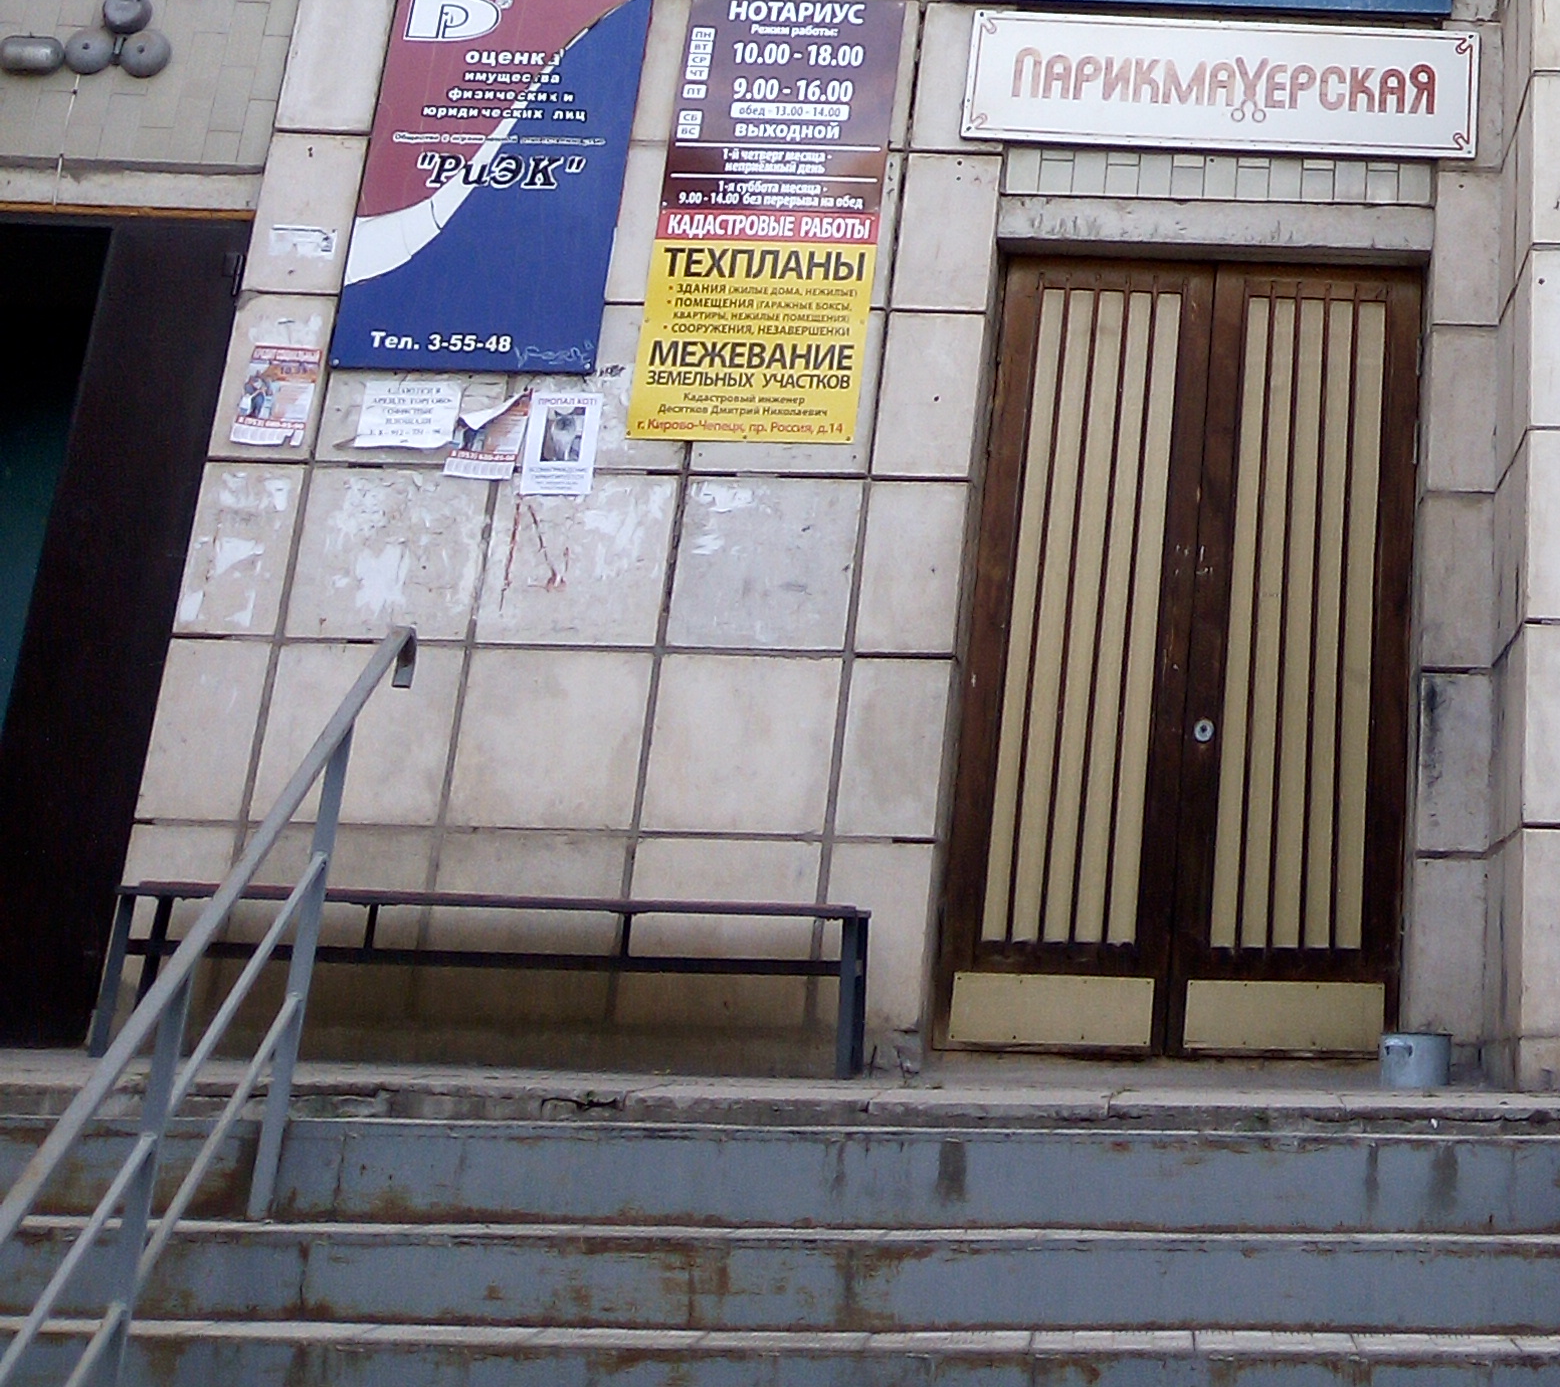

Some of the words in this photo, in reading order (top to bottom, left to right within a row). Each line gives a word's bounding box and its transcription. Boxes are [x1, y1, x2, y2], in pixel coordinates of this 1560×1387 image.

[728, 0, 865, 25] НОТАРИУС
[751, 24, 789, 36] Режим
[791, 26, 839, 38] работы:
[733, 43, 790, 65] 10.00
[808, 45, 864, 66] 18.00
[733, 78, 779, 100] 9.00
[796, 80, 853, 101] 16.00
[1011, 46, 1435, 120] ПАРИКМАХЕРСКАЯ
[563, 92, 573, 102] и
[422, 105, 543, 120] юридических
[553, 108, 587, 122] лиц
[739, 105, 765, 117] обед
[775, 105, 804, 117] 13.00
[813, 106, 841, 118] 14.00
[741, 150, 784, 163] четверг
[785, 152, 825, 163] месяца
[797, 163, 825, 174] день
[737, 181, 779, 195] суббота
[781, 184, 821, 195] месяца
[678, 192, 702, 204] 9.00
[711, 193, 739, 205] 14.00
[742, 194, 762, 205] без
[763, 195, 818, 208] перерыва
[820, 197, 834, 206] на
[835, 194, 864, 209] обед
[667, 213, 794, 238] КАДАСТРОВЫЕ
[799, 215, 872, 239] РАБОТЫ
[664, 247, 867, 281] ТЕХПЛАНЫ
[676, 283, 726, 295] ЗДАНИЯ
[674, 297, 754, 309] ПОМЕЩЕНИЯ
[671, 323, 755, 336] СООРУЖЕНИЯ,
[757, 325, 850, 337] НЕЗАВЕРШЕНКИ
[371, 331, 419, 350] Тел.
[428, 334, 512, 353] 3-55-48
[648, 340, 855, 371] МЕЖЕВАНИЕ
[646, 371, 754, 388] ЗЕМЕЛЬНЫХ
[761, 373, 851, 390] УЧАСТКОВ
[539, 398, 576, 406] ПРОПАЛ
[683, 393, 756, 404] Кадастровый
[758, 396, 805, 406] инженер
[710, 406, 760, 416] Дмитрий
[749, 423, 767, 433] пр.
